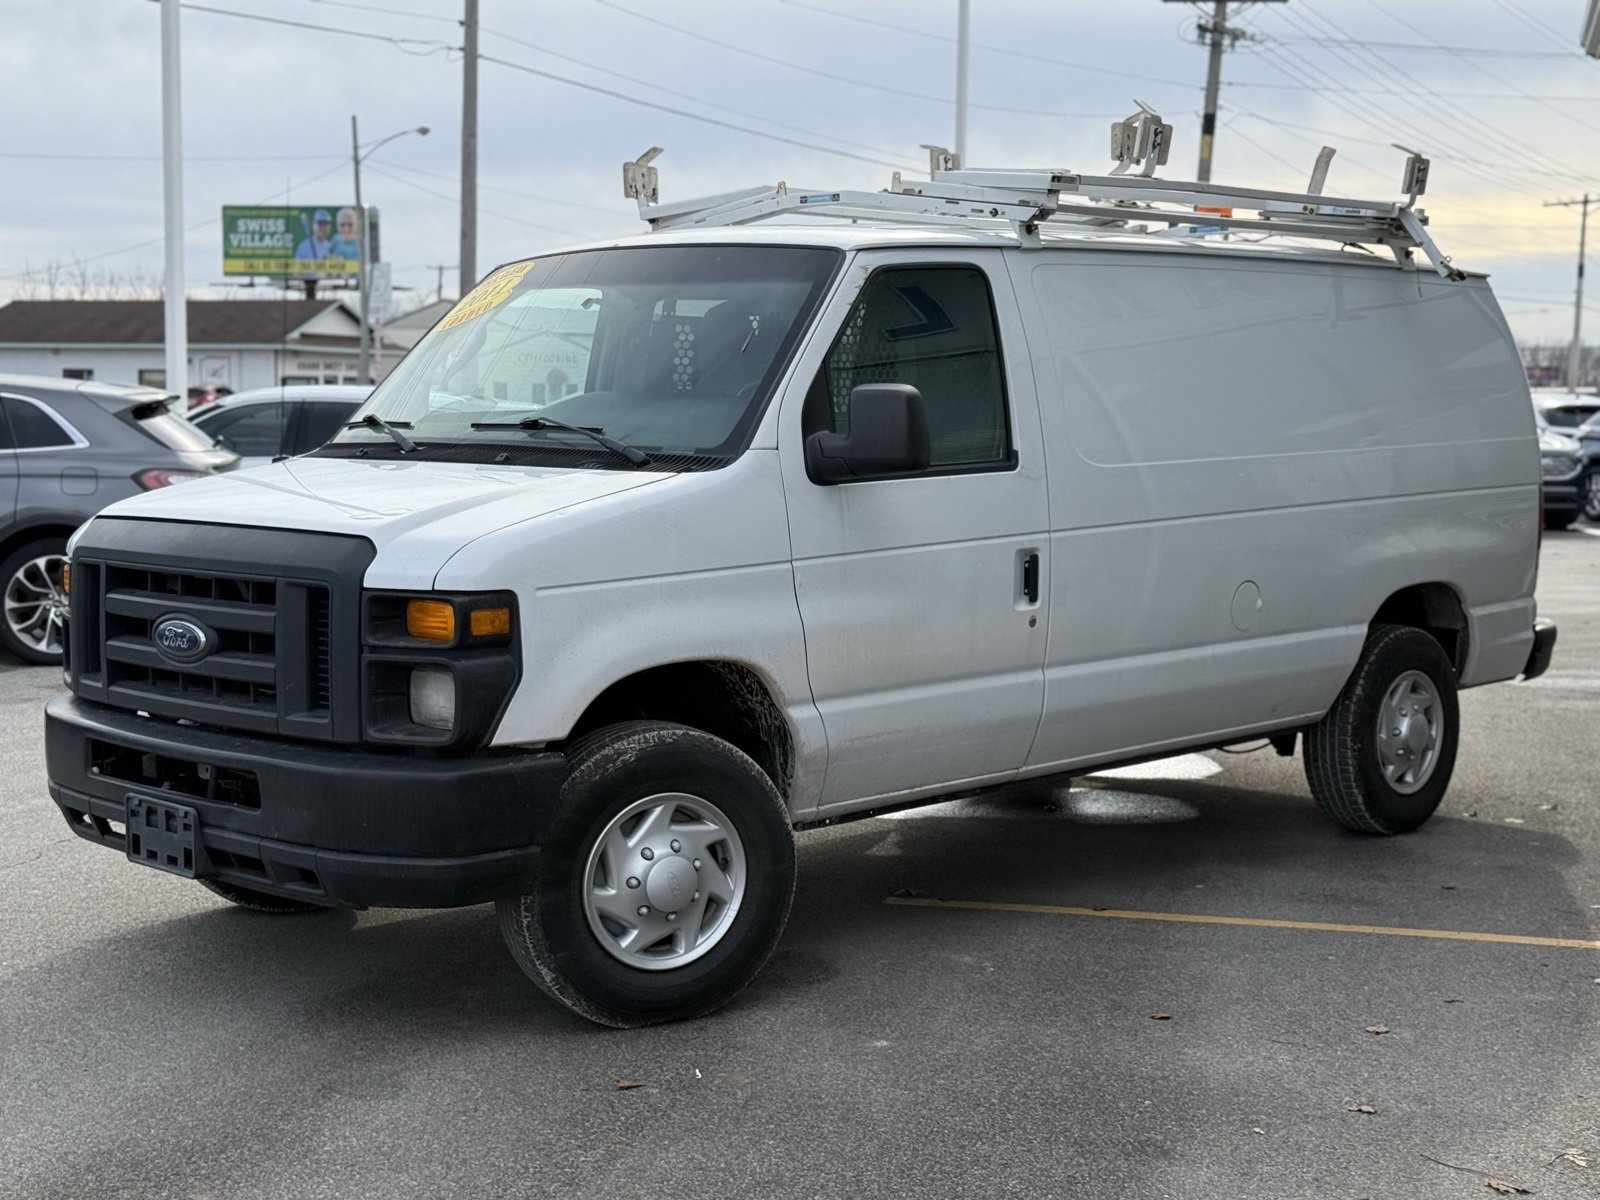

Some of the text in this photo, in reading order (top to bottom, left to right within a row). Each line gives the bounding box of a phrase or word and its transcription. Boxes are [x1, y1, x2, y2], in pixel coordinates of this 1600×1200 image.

[237, 218, 286, 233] SWISS
[229, 233, 294, 248] VILLAGE
[441, 301, 493, 330] LOADED
[163, 626, 190, 649] Ford
